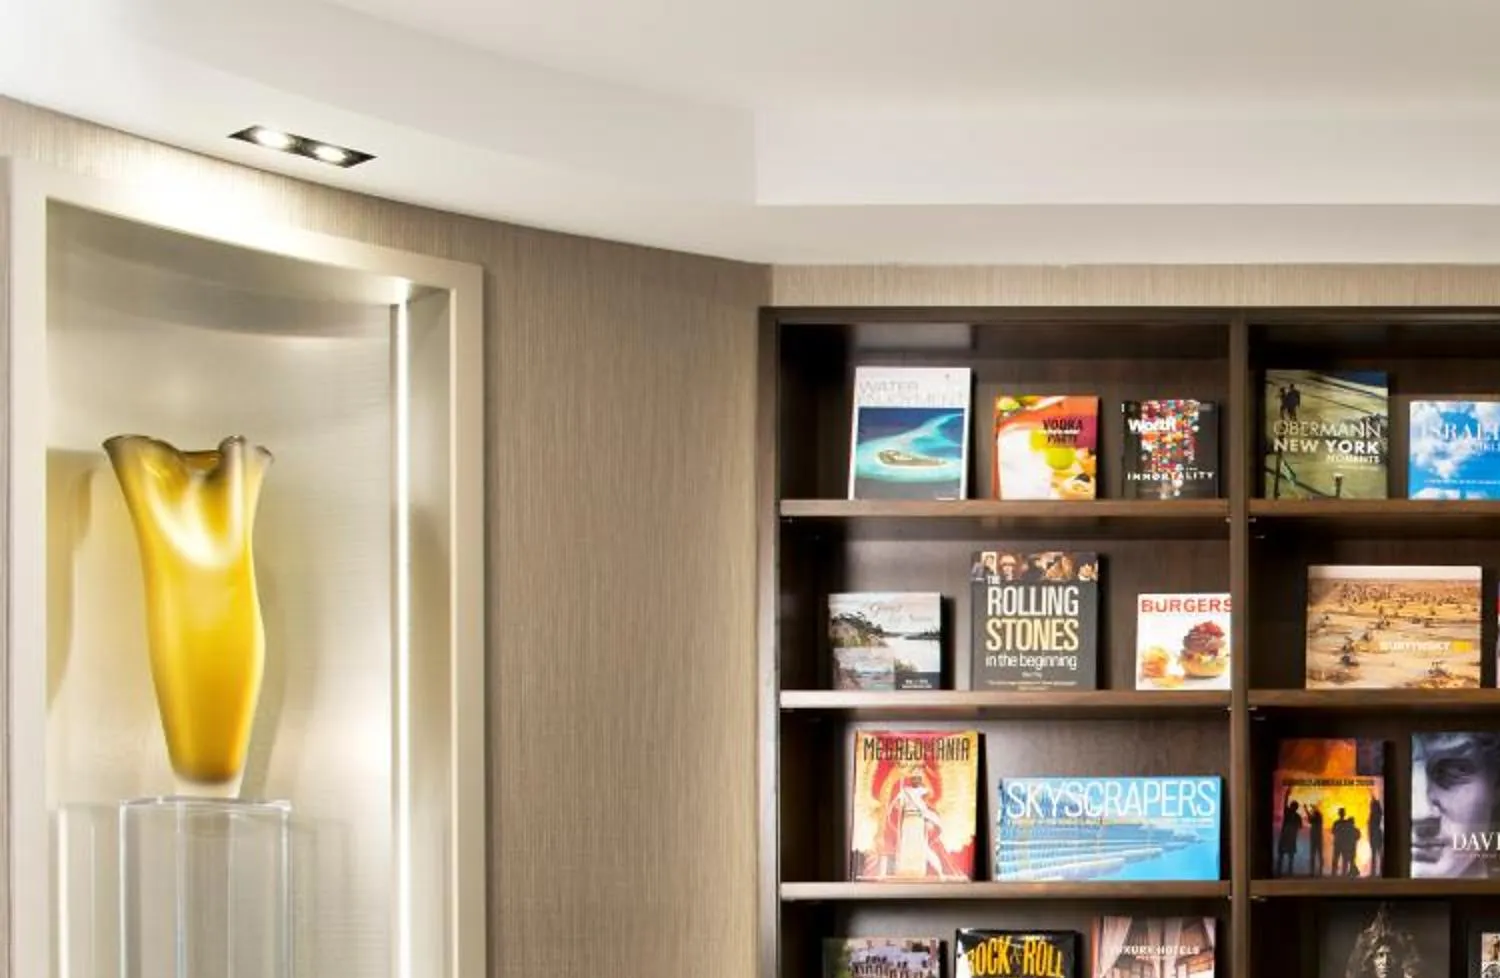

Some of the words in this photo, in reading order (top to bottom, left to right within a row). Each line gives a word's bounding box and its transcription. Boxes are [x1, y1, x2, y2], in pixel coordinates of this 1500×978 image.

[1042, 418, 1083, 430] VODKA
[1128, 418, 1176, 432] Worth
[1273, 420, 1381, 438] OBERMANN
[1273, 438, 1319, 453] NEW
[1325, 439, 1380, 454] YORK
[1127, 471, 1214, 480] IMMORTALITY
[986, 585, 1080, 617] ROLLING
[1141, 599, 1232, 613] BURGERS
[986, 618, 1080, 651] STONES
[985, 654, 997, 667] in
[998, 653, 1017, 667] the
[1019, 652, 1077, 671] beginning
[863, 736, 970, 761] MEGALOMANIA
[1006, 780, 1216, 818] SKYSCRAPERS
[967, 936, 1012, 977] ROCK
[1023, 936, 1066, 978] ROLL
